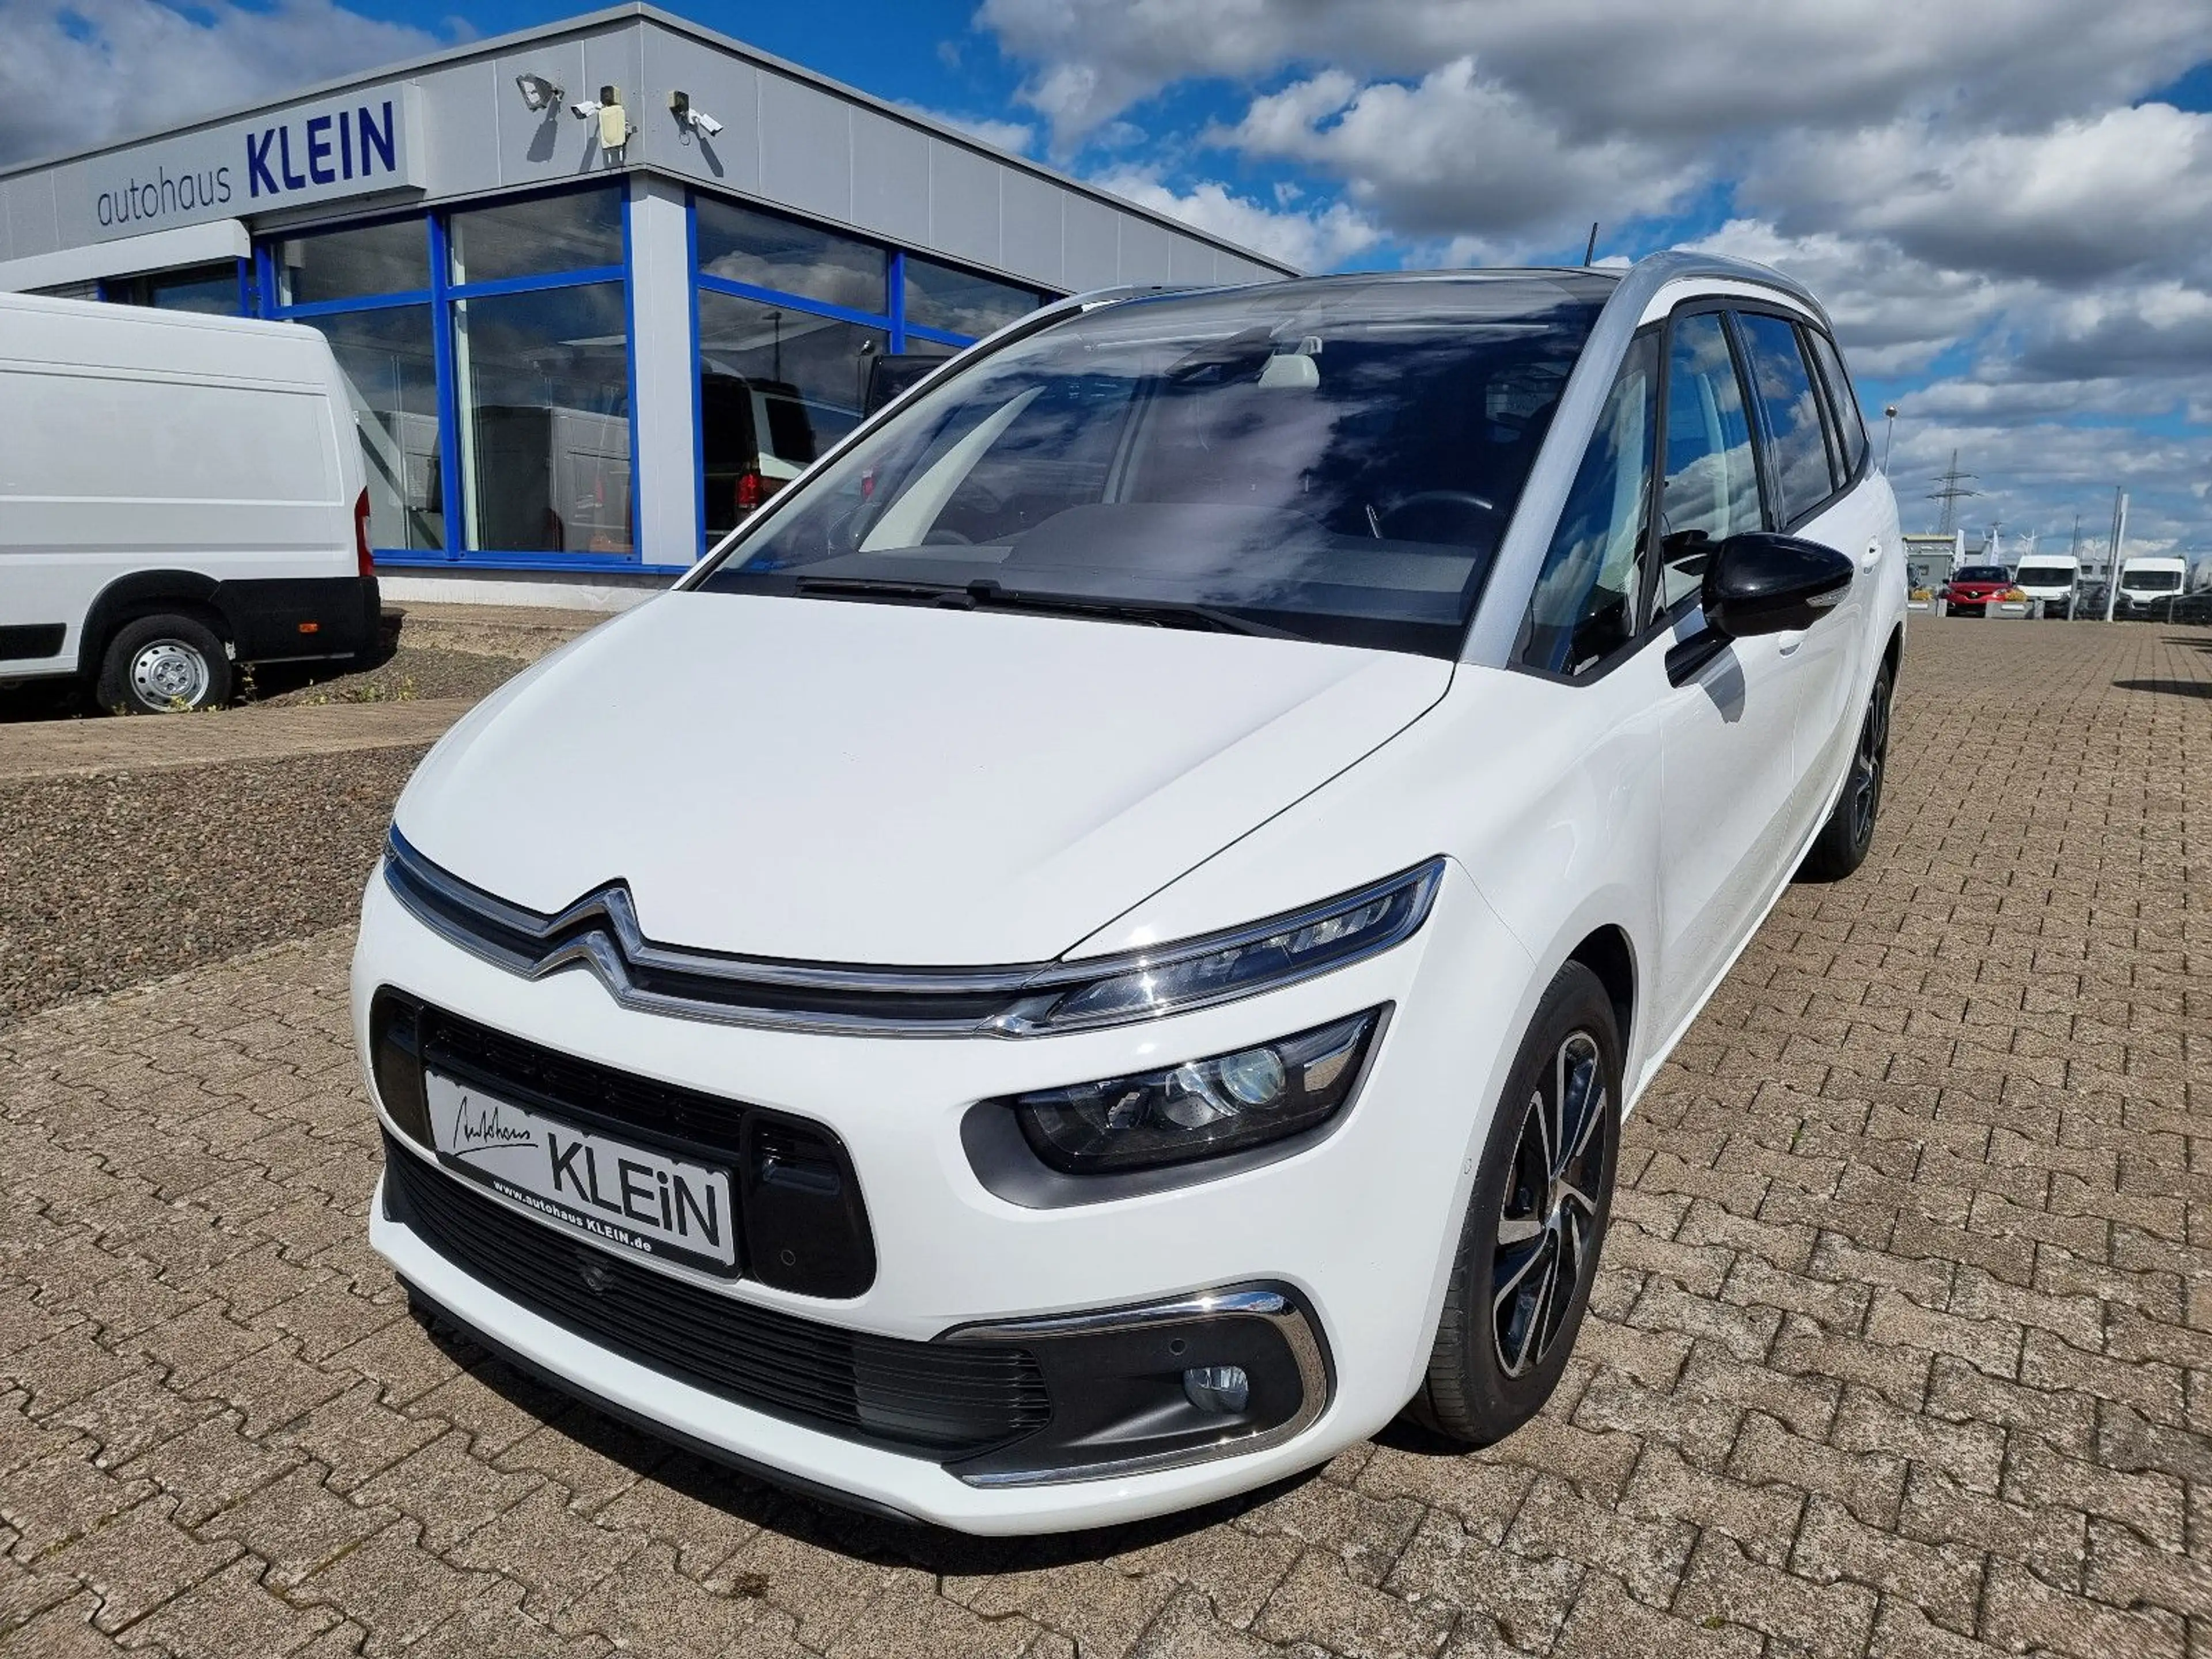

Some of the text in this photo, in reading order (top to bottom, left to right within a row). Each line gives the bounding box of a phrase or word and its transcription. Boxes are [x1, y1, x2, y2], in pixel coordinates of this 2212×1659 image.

[98, 101, 396, 225] autohaus KLEIN
[493, 1180, 652, 1252] www.autohaus KLEIN.de
